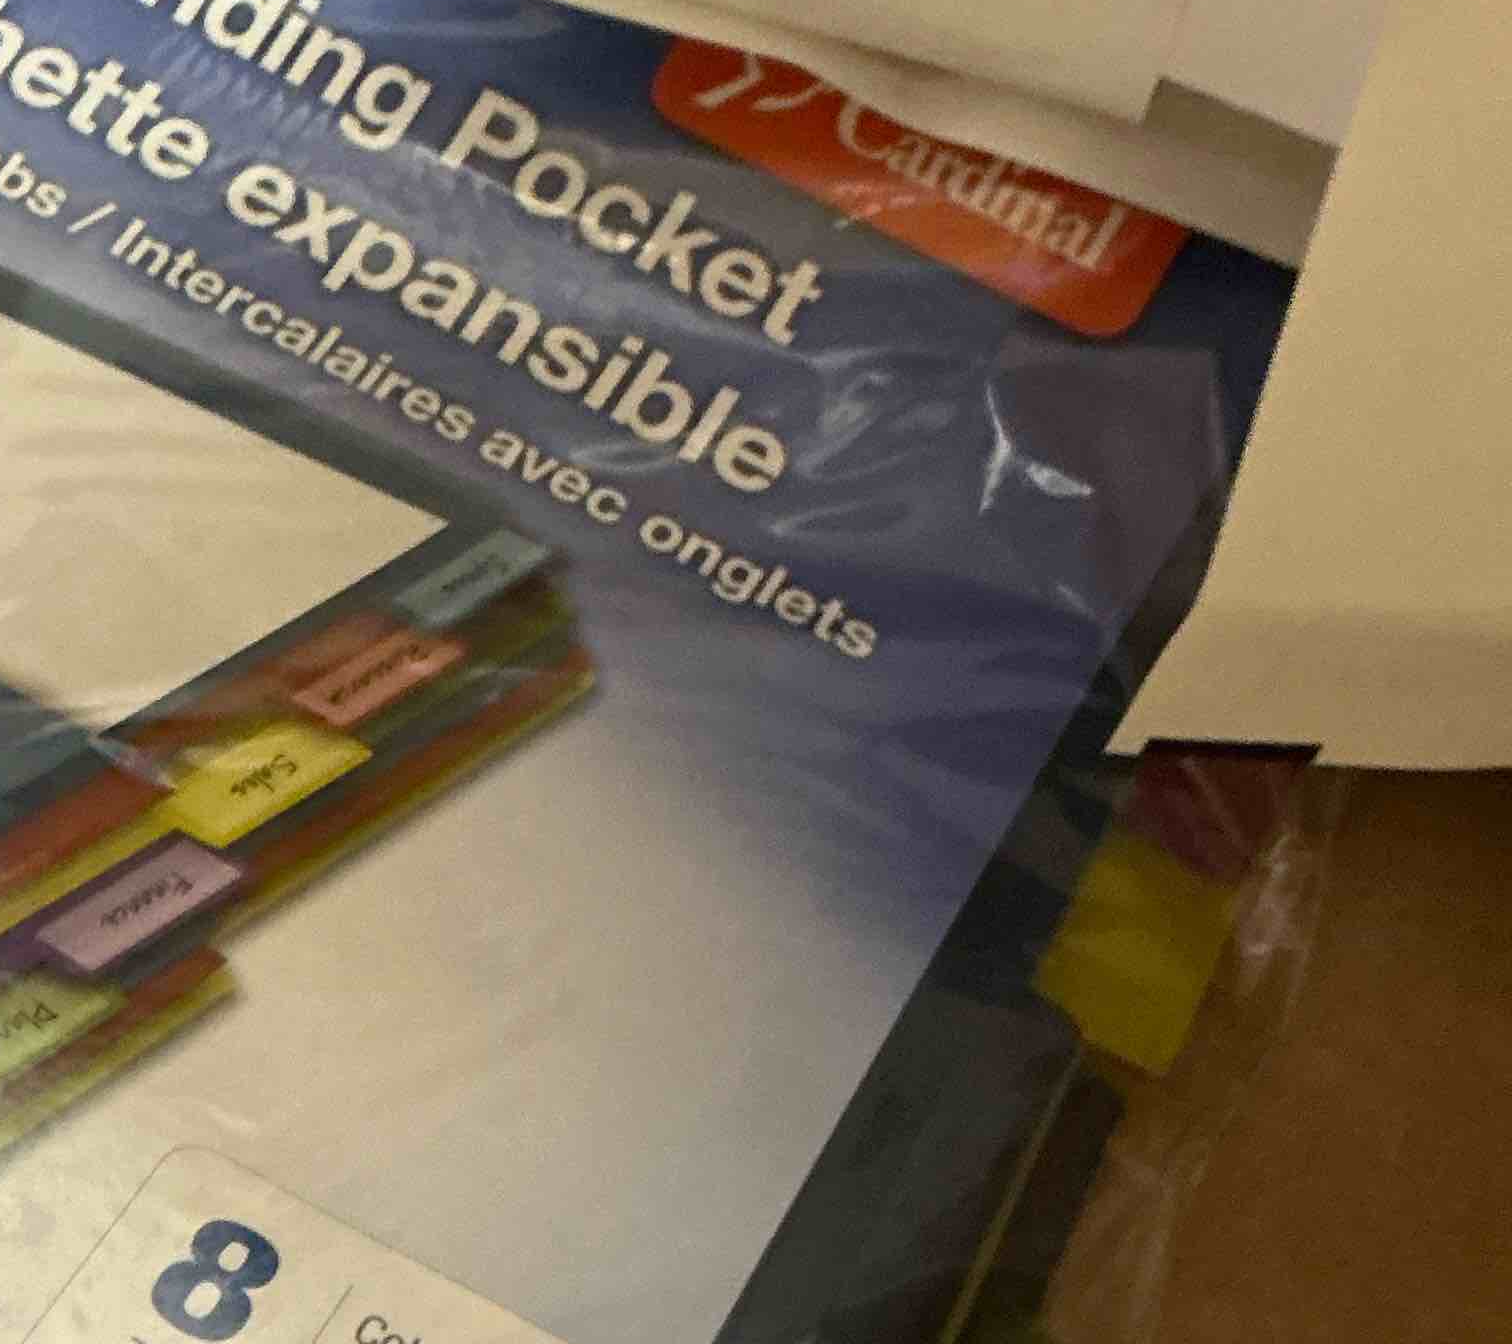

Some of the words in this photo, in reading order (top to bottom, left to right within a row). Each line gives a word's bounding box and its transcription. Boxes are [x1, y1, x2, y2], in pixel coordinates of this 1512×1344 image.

[444, 89, 821, 347] Pocket
[837, 94, 1127, 272] Cardinal
[110, 218, 475, 443] Intercalaires
[480, 427, 630, 526] avec
[639, 514, 878, 659] onglets
[227, 162, 787, 493] expansible
[150, 1217, 282, 1342] 8
